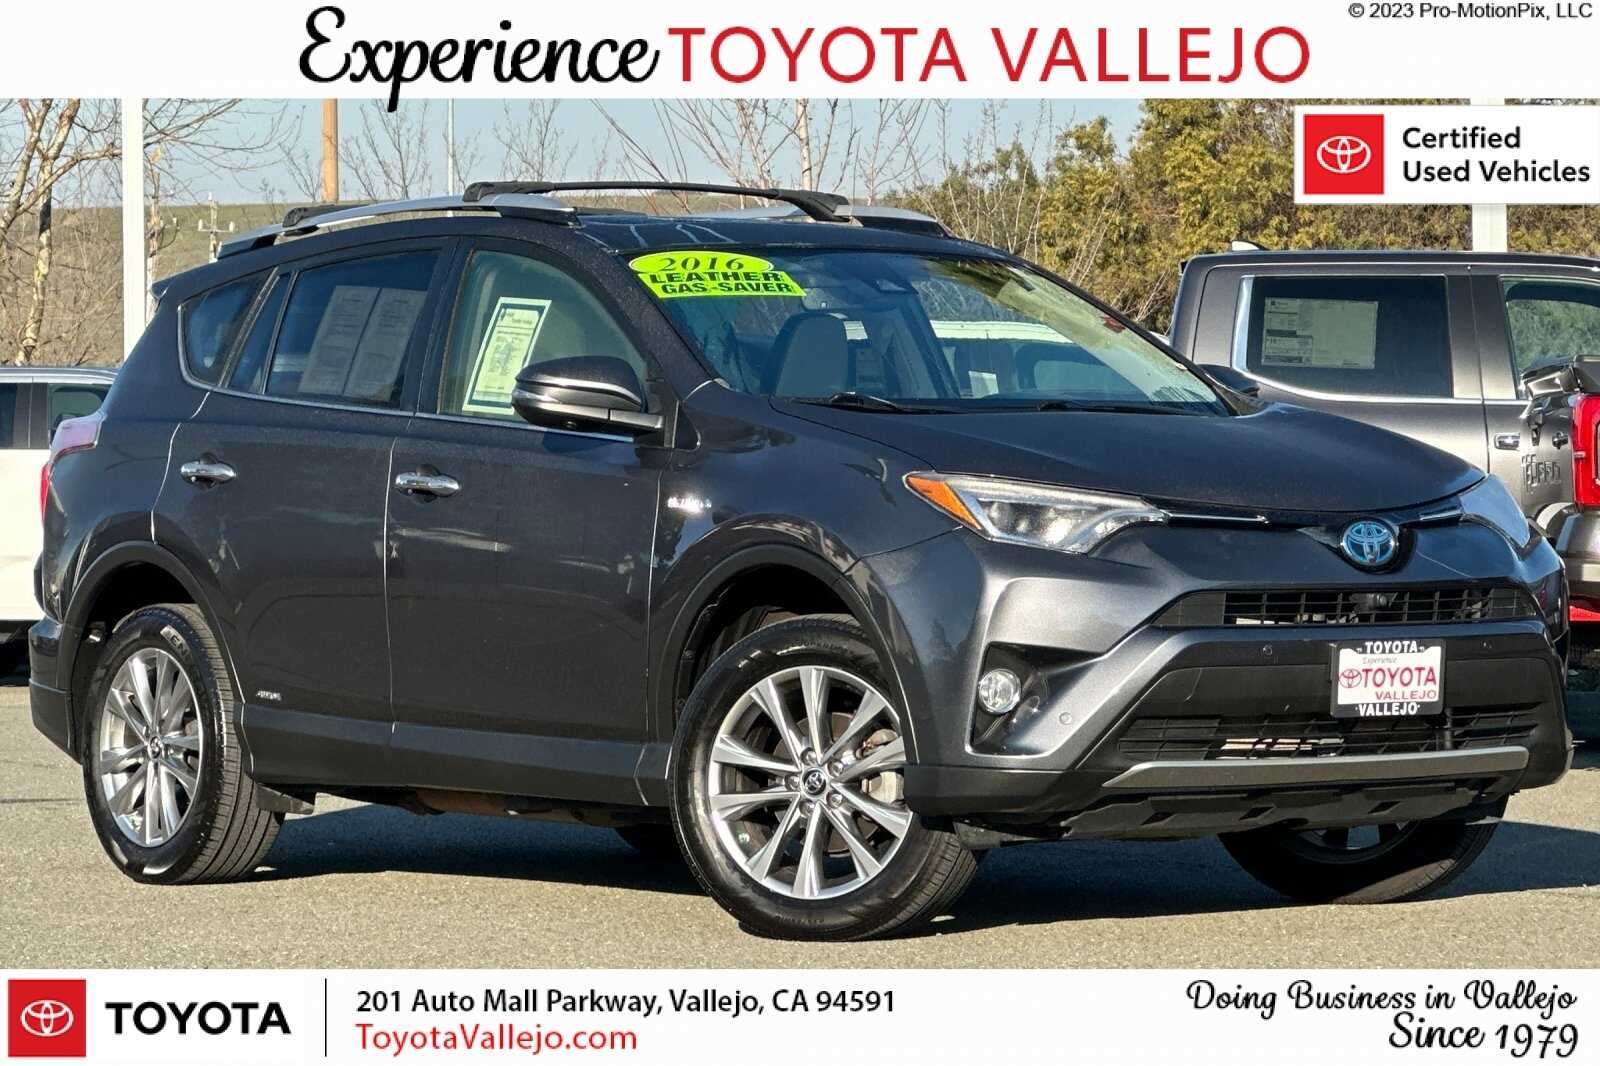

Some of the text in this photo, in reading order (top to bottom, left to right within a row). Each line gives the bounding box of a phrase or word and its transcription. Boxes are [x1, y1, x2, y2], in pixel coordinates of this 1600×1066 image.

[657, 257, 745, 272] 2016
[649, 270, 783, 284] LEATHER
[661, 282, 793, 294] GAS-SAVER
[1365, 640, 1418, 654] TOYOTA
[1362, 666, 1437, 688] TOYOTA
[1375, 690, 1437, 700] VALLEJO
[1358, 702, 1418, 717] VALLEJO
